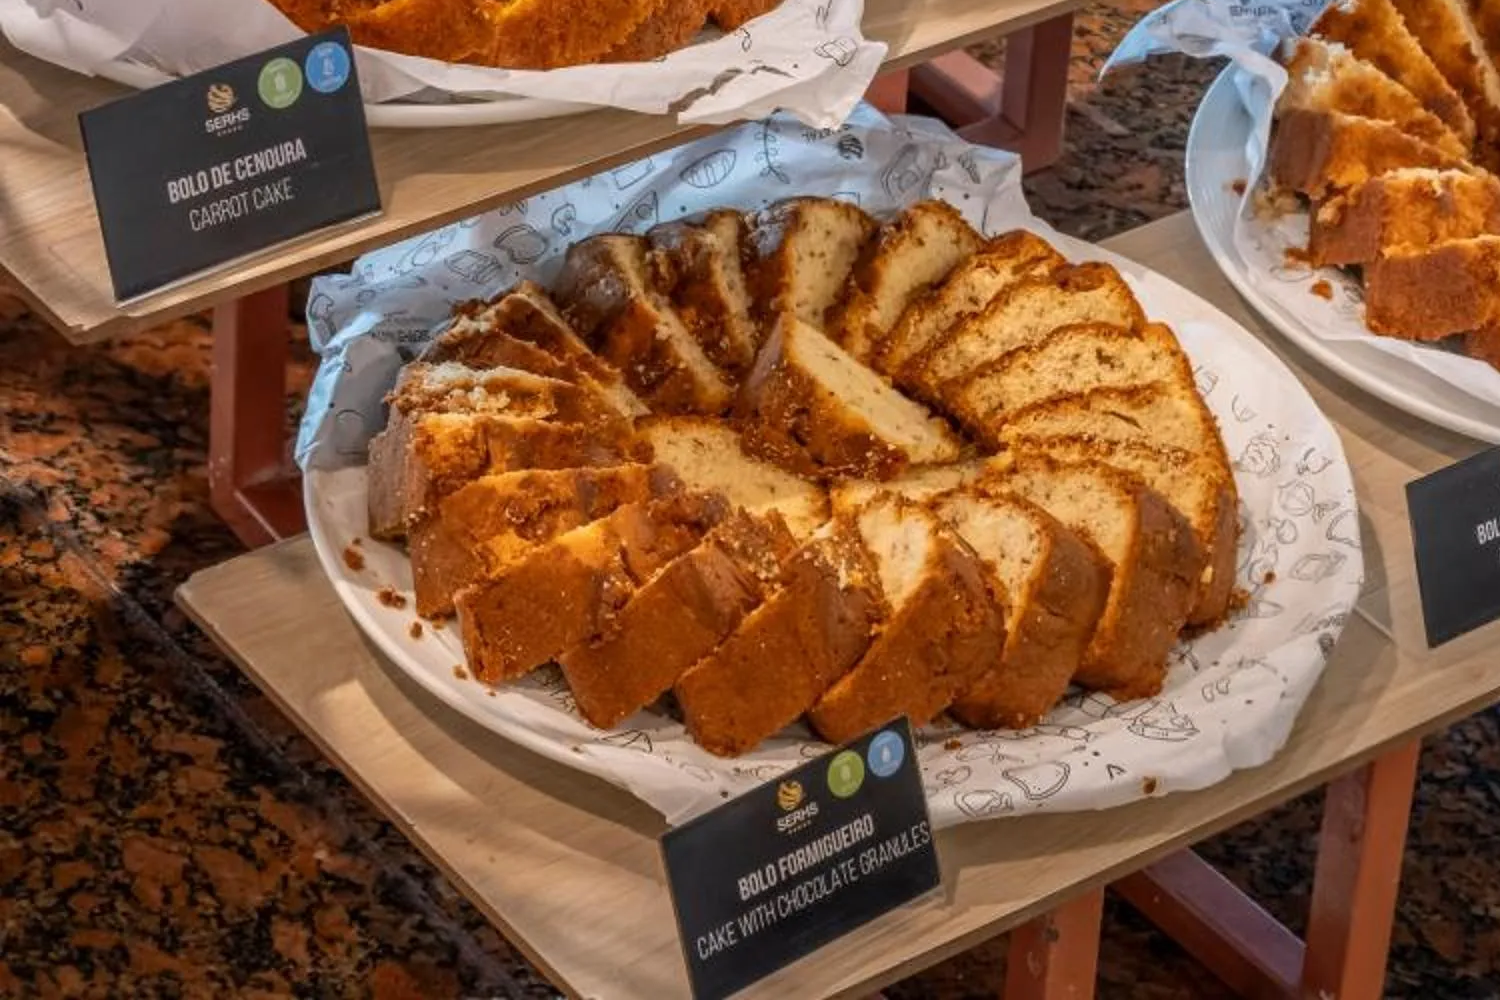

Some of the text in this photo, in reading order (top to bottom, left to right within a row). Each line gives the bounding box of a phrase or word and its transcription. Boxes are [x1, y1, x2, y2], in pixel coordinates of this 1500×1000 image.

[205, 108, 250, 133] SERHS
[167, 138, 307, 203] BOLO DE CENOURA
[189, 177, 295, 231] CARROT CAKE
[777, 802, 819, 832] SERHS
[738, 814, 875, 900] BOLO FORMIGUEIRO
[697, 821, 931, 961] CAKE WITH CHOCOLATE GRANULES
